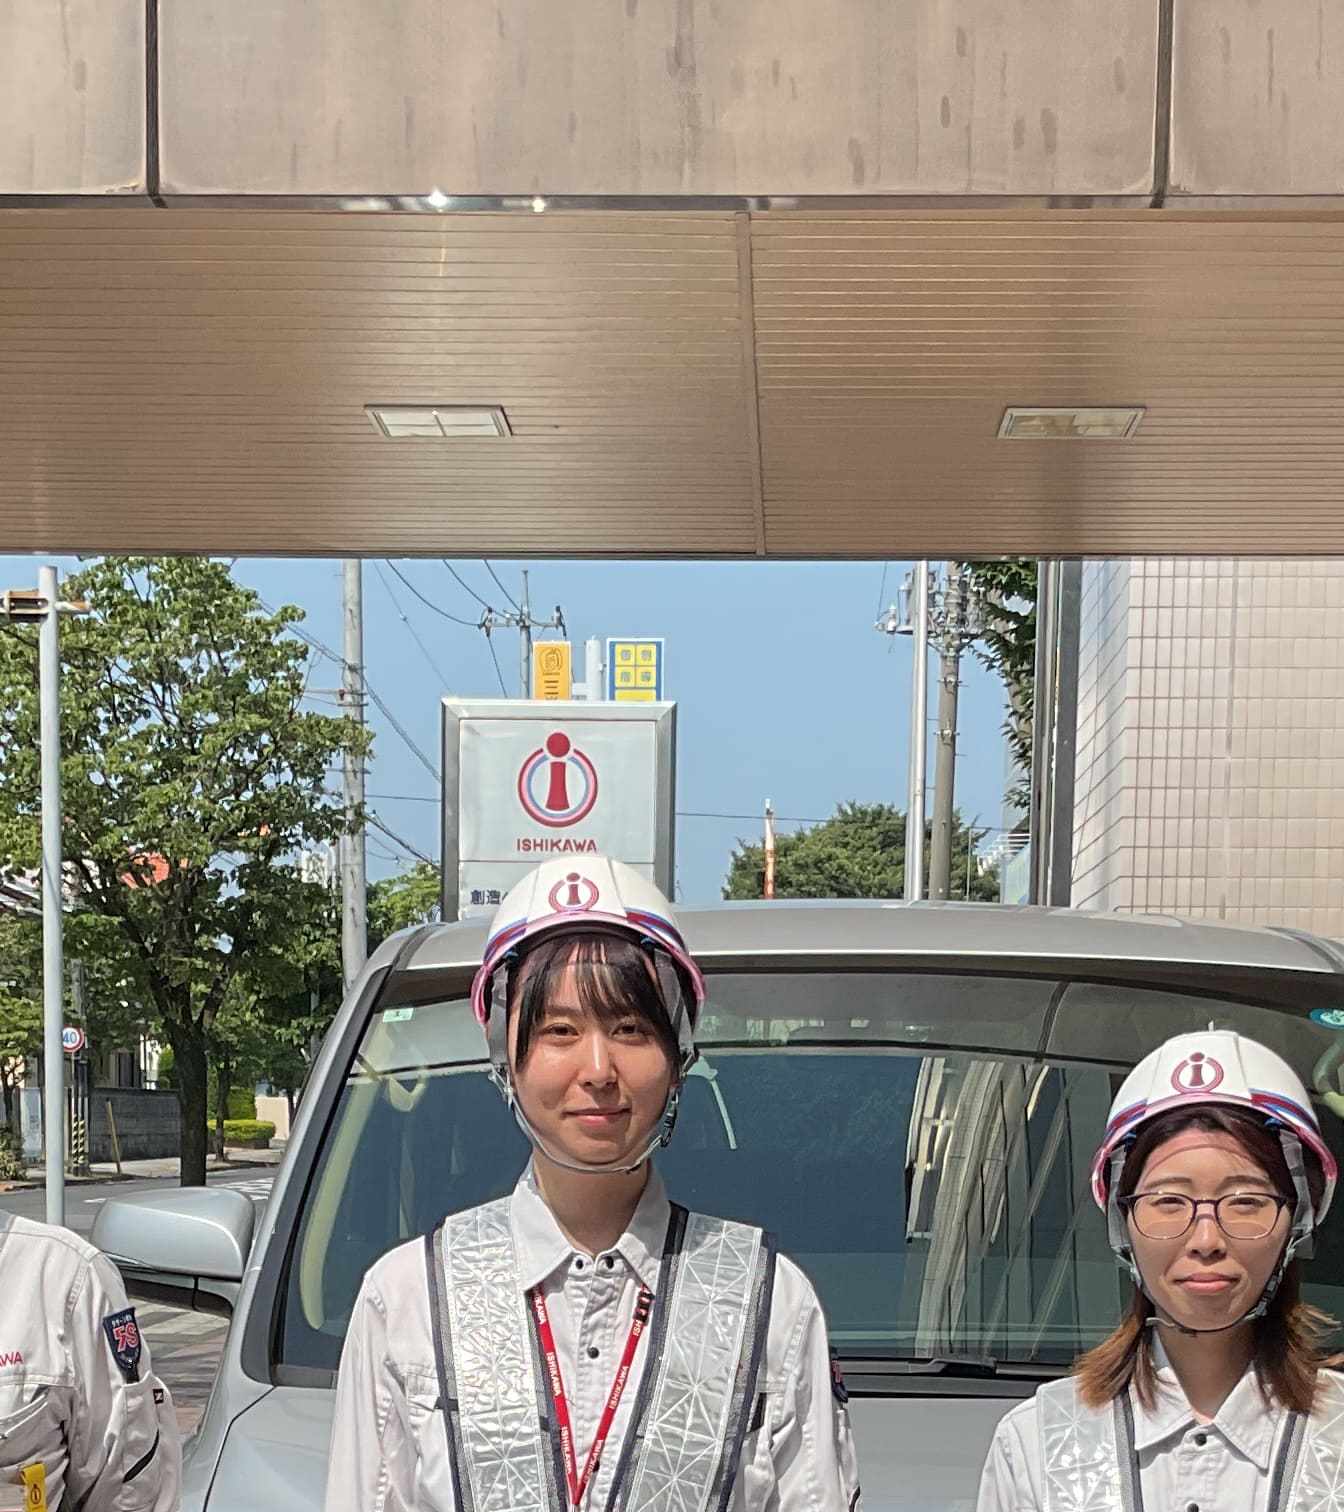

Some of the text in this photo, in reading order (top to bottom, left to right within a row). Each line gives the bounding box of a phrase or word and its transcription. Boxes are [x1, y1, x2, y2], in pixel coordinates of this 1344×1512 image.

[517, 838, 598, 853] ISHIKAWA
[113, 1322, 138, 1352] 5S
[545, 1352, 561, 1397] ISHIKAWA
[609, 1365, 630, 1410] ISHIKAWA
[561, 1427, 572, 1474] ISHIKAWA
[584, 1440, 604, 1484] ISHIKAWA
